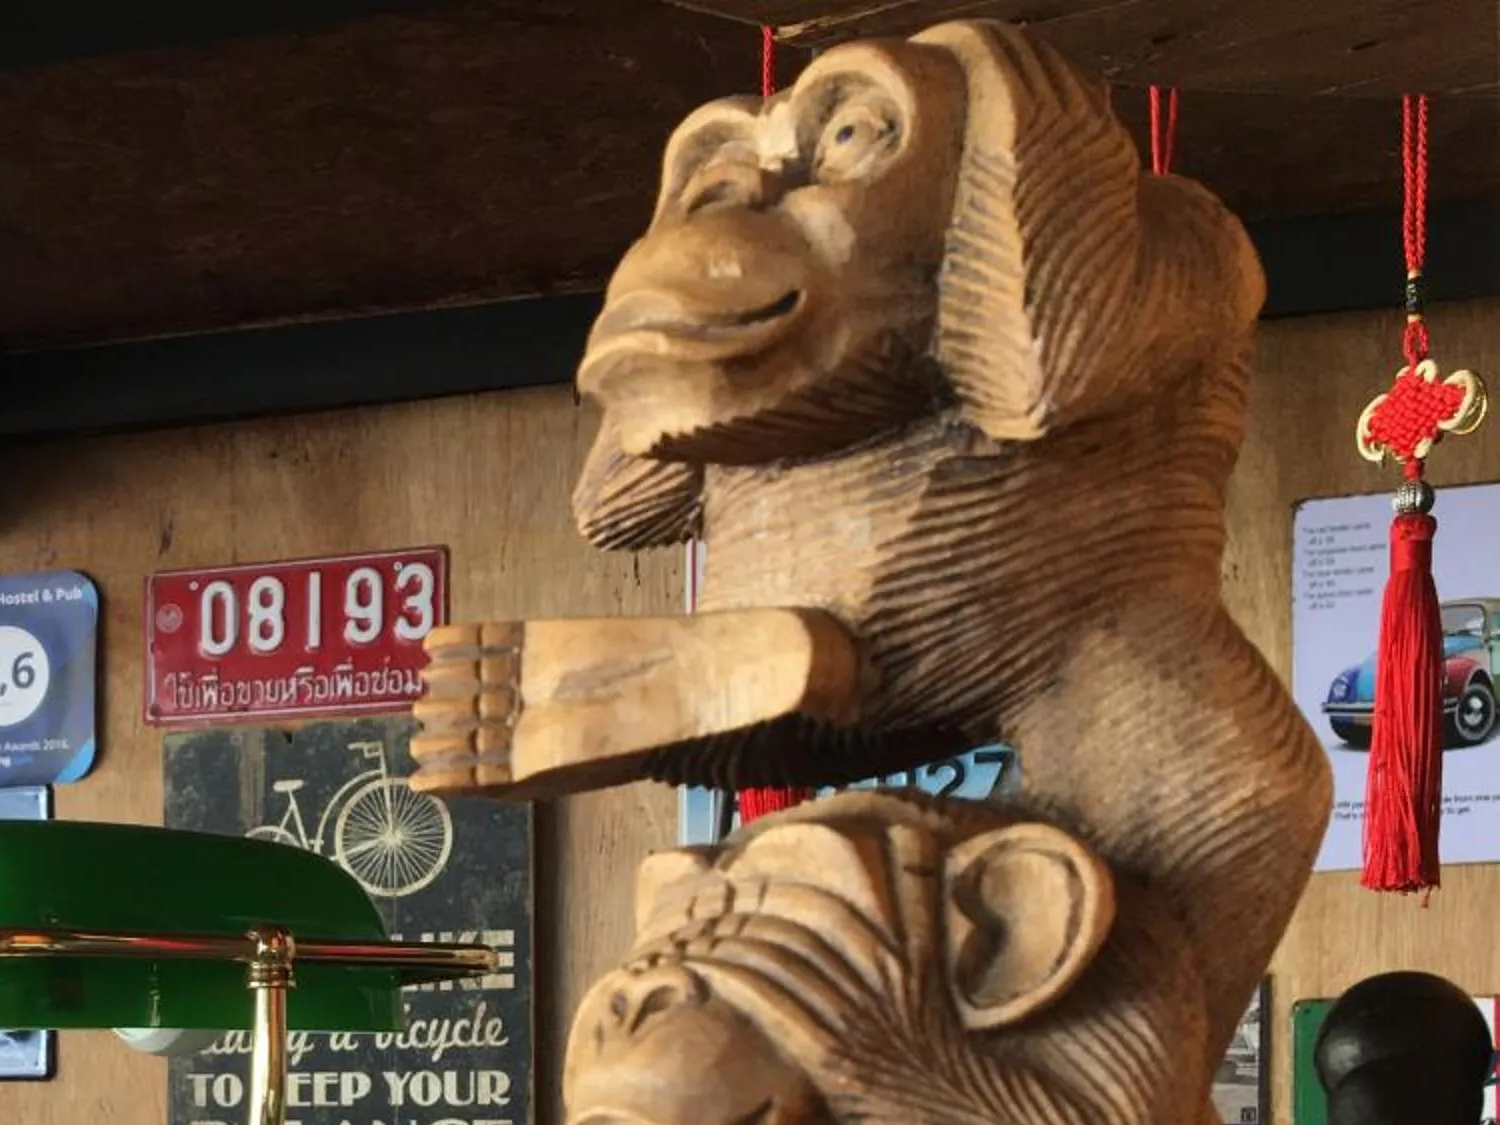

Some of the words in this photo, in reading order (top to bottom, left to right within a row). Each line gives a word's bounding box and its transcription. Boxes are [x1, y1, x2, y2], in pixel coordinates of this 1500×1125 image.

[55, 585, 83, 601] Pub
[200, 562, 435, 655] 08193
[186, 1072, 244, 1108] TO
[285, 1071, 373, 1107] EEP
[384, 1070, 511, 1107] YOUR
